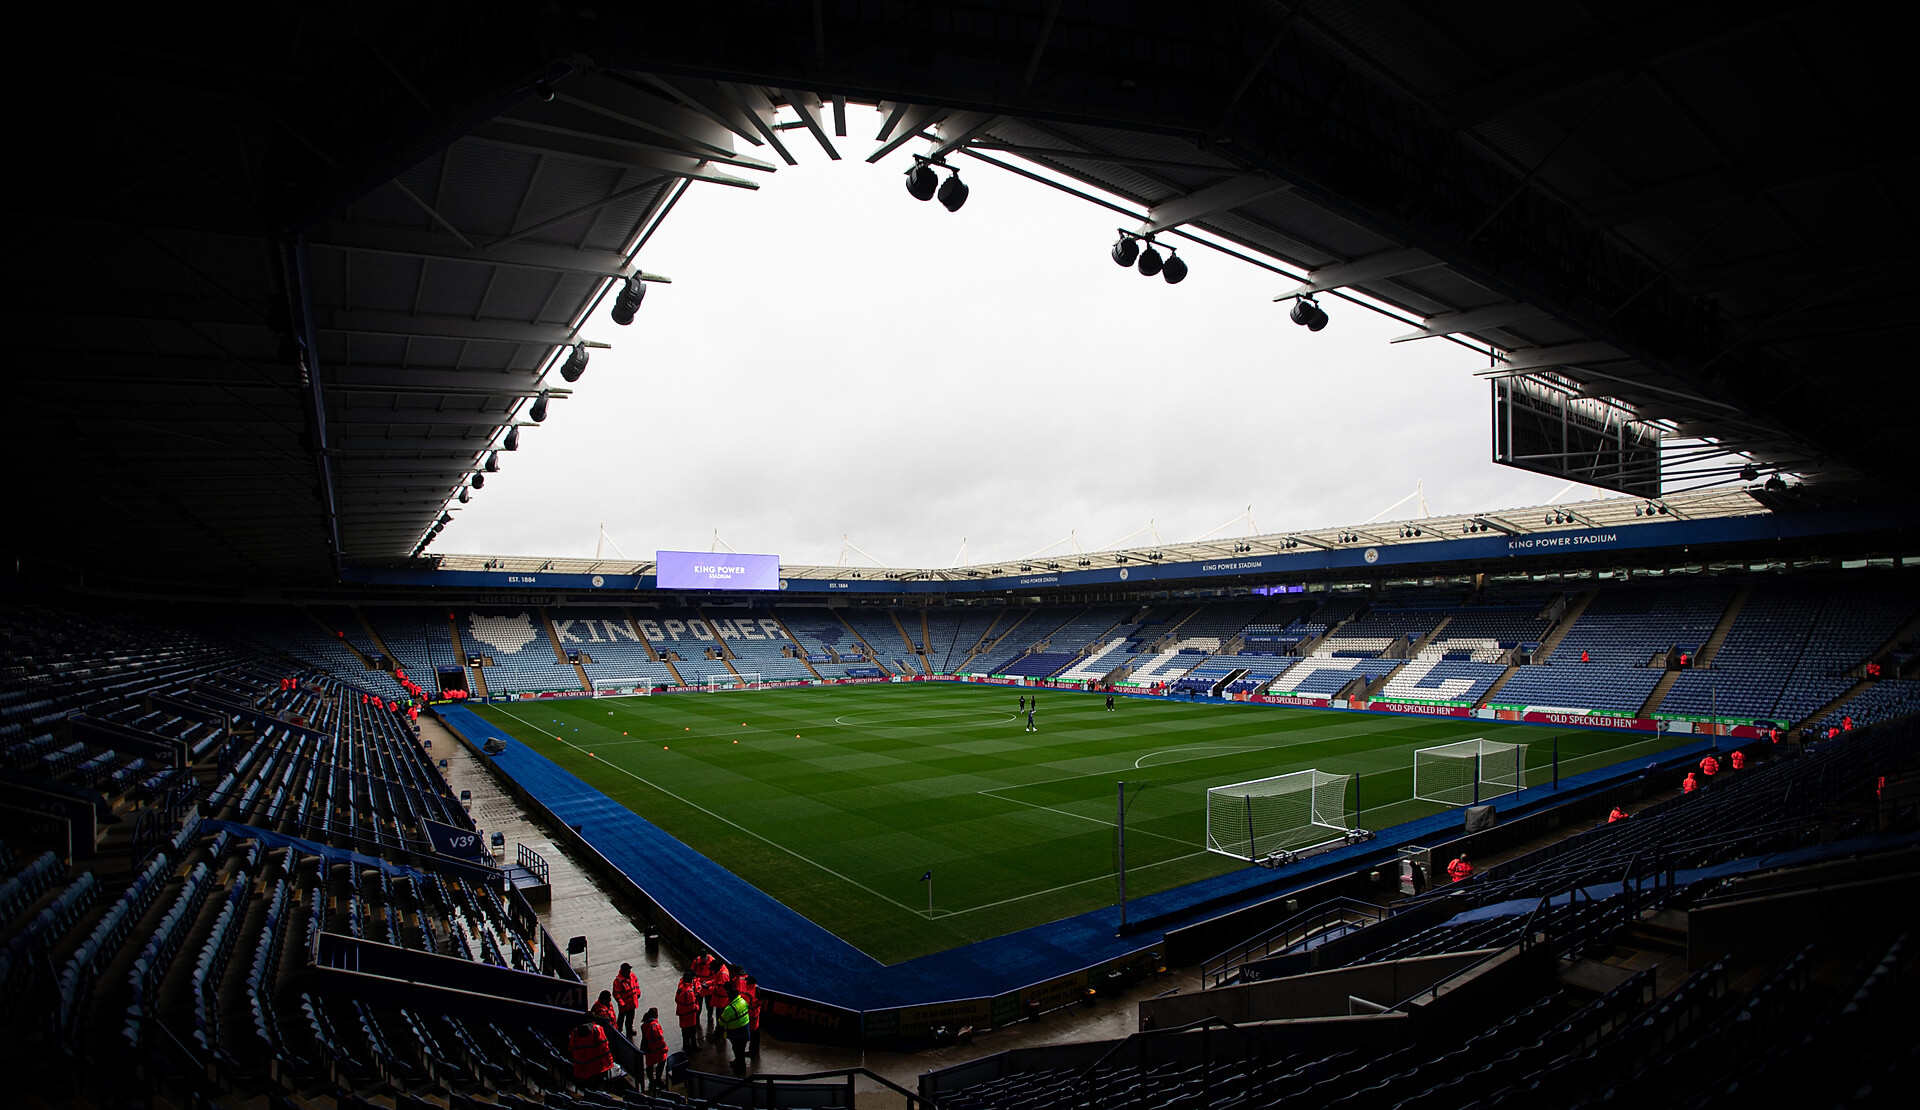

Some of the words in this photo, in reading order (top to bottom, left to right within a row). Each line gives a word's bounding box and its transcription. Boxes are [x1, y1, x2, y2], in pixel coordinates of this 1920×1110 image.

[1509, 540, 1534, 549] KING
[1536, 538, 1571, 547] POWER
[1574, 534, 1617, 545] STADIUM
[694, 565, 716, 573] KING
[1238, 561, 1262, 569] STADIUM
[1276, 697, 1301, 705] SPECKLED
[1386, 704, 1402, 712] "OLD
[1403, 705, 1435, 714] SPECKLED
[1437, 706, 1454, 715] HEN"
[1546, 714, 1567, 723] "OLD
[1569, 715, 1611, 726] SPECKLED
[1613, 718, 1637, 728] HEN"
[450, 835, 475, 848] V39
[545, 986, 583, 1006] V41
